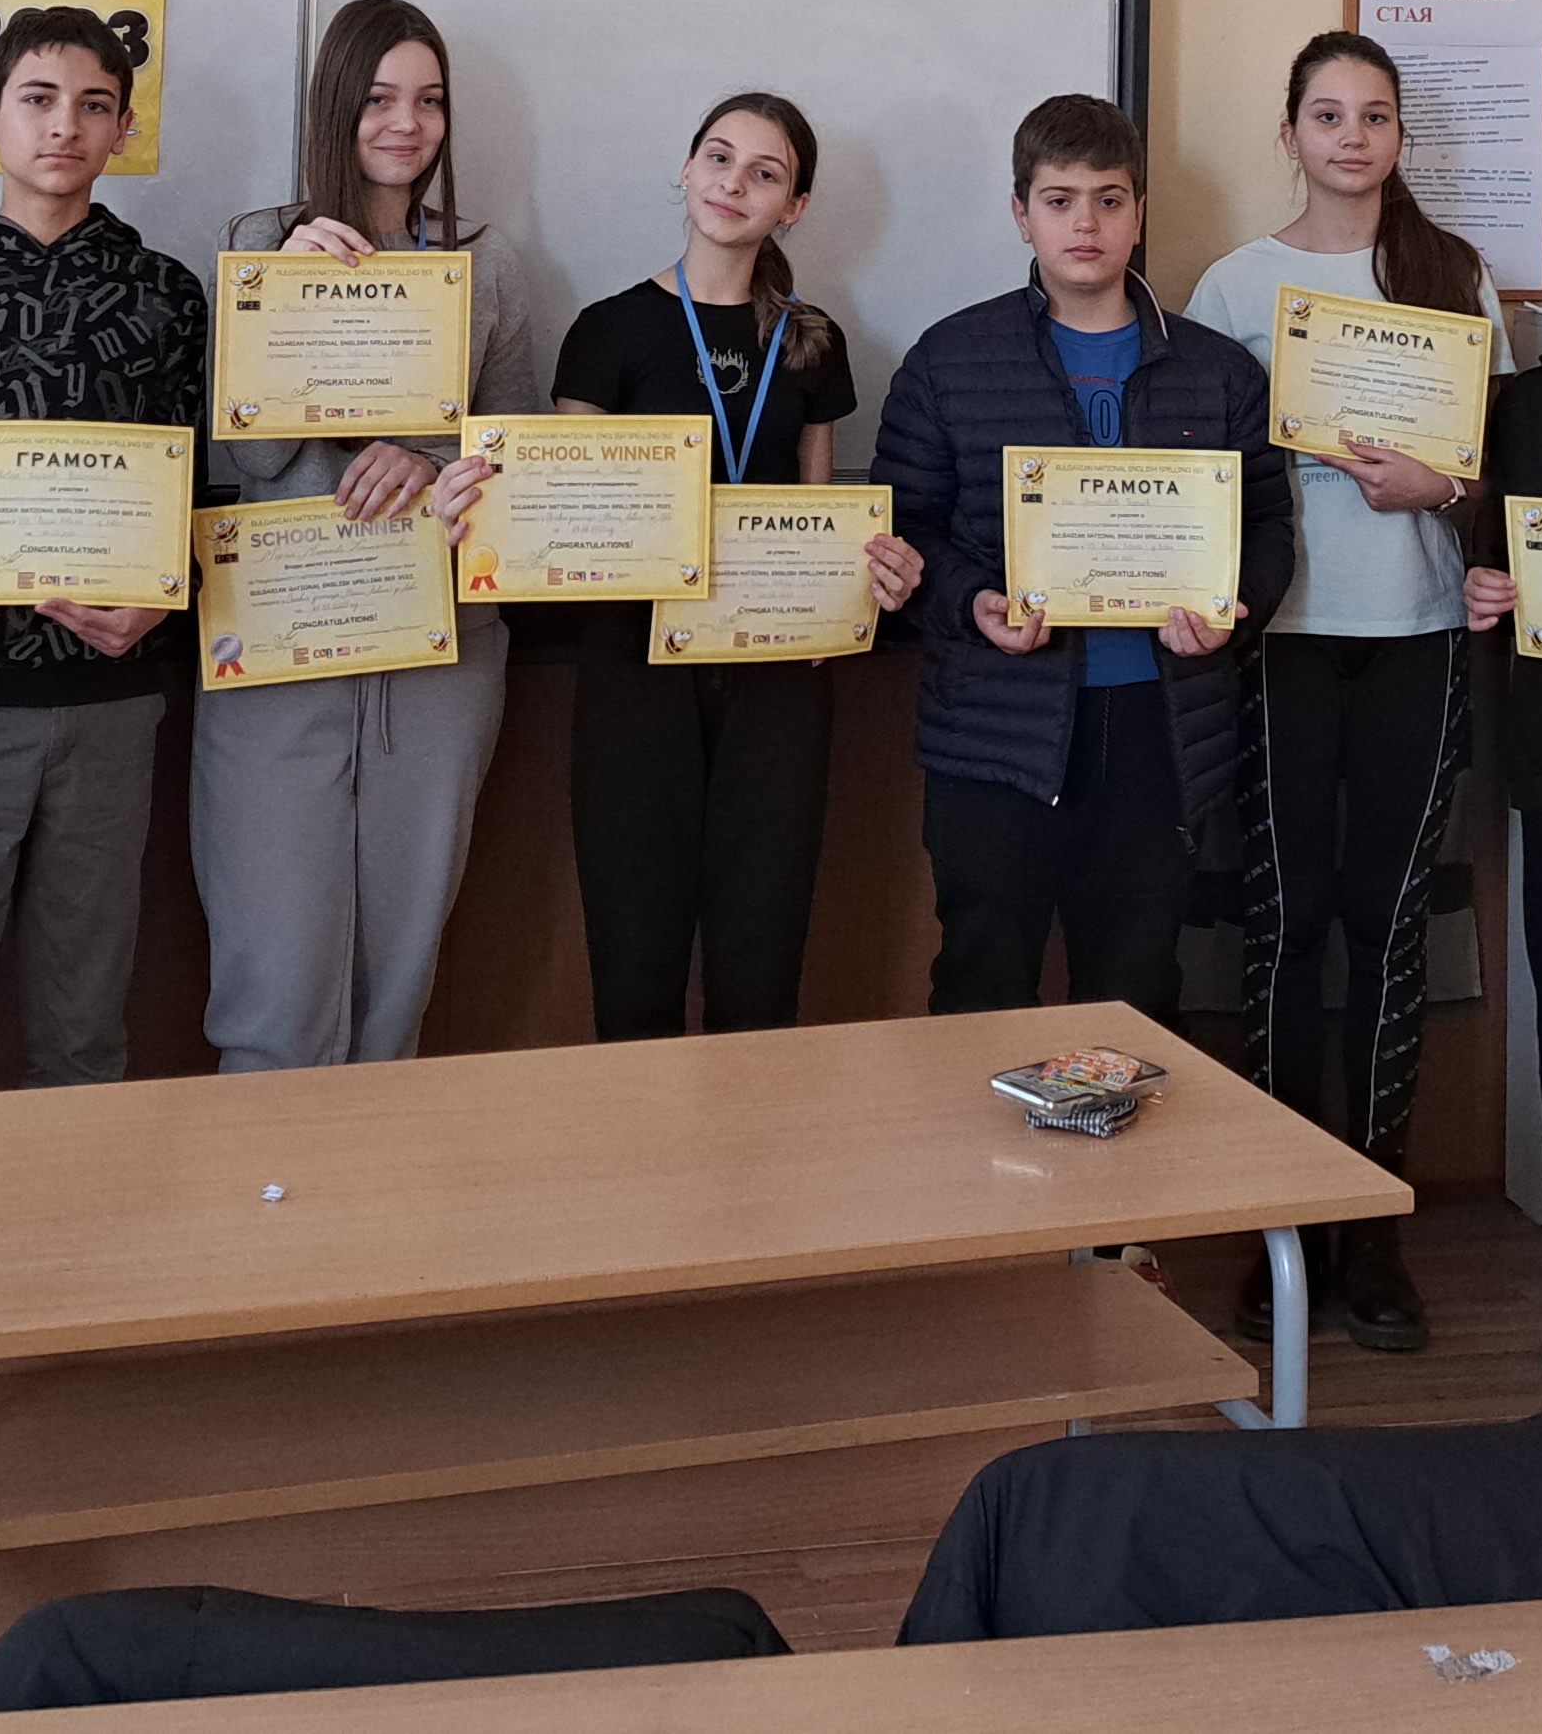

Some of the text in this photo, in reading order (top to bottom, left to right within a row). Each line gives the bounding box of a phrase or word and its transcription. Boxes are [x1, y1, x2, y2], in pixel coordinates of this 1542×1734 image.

[1376, 5, 1433, 24] СТАЯ
[302, 284, 407, 299] ГРАМОТА
[1341, 323, 1435, 351] ГРАМОТА
[16, 452, 128, 470] ГРАМОТА
[516, 445, 676, 461] SCHOOL WINNER
[1080, 479, 1180, 495] ГРАМОТА
[1301, 472, 1339, 486] green
[738, 516, 835, 531] ГРАМОТА
[250, 518, 414, 548] SCHOOL WINNER
[20, 544, 111, 555] CONGRATULATIONS!
[292, 614, 378, 631] CONGRATULATIONS!
